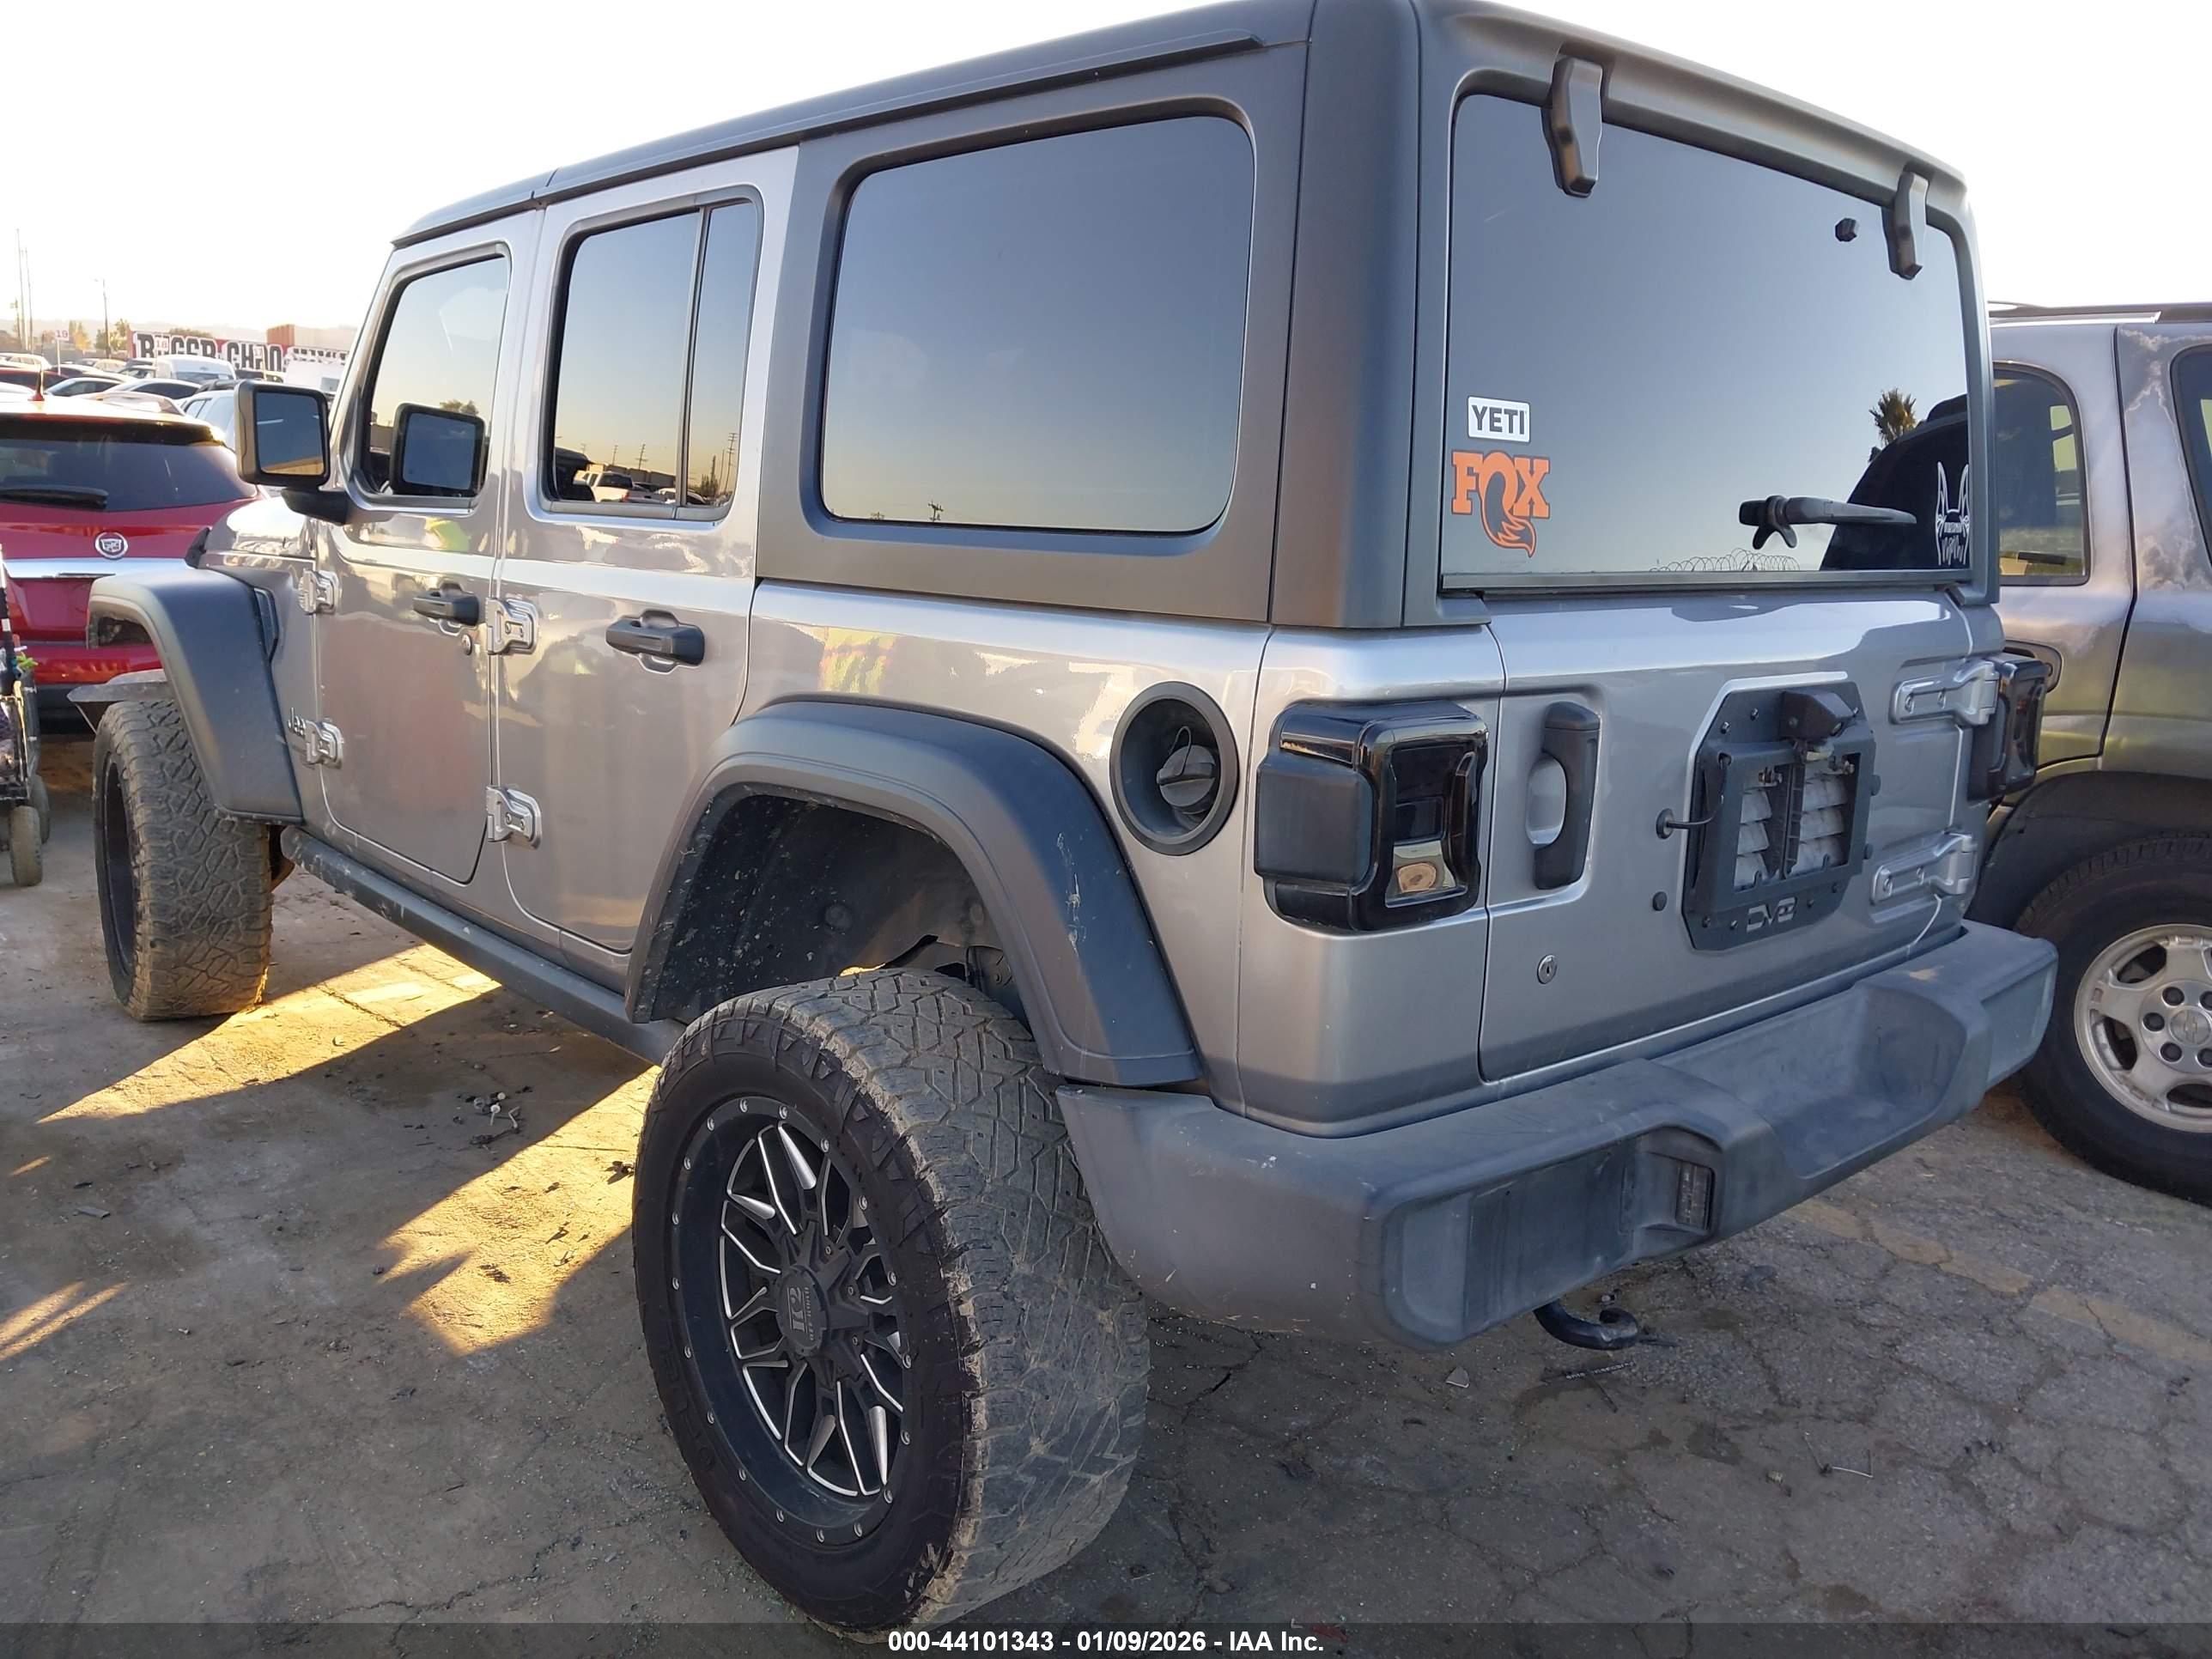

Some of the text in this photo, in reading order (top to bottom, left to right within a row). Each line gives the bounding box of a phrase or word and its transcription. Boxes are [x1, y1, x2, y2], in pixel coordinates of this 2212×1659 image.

[1471, 404, 1525, 435] YETI
[1451, 450, 1551, 555] FOX
[288, 707, 307, 737] Jee
